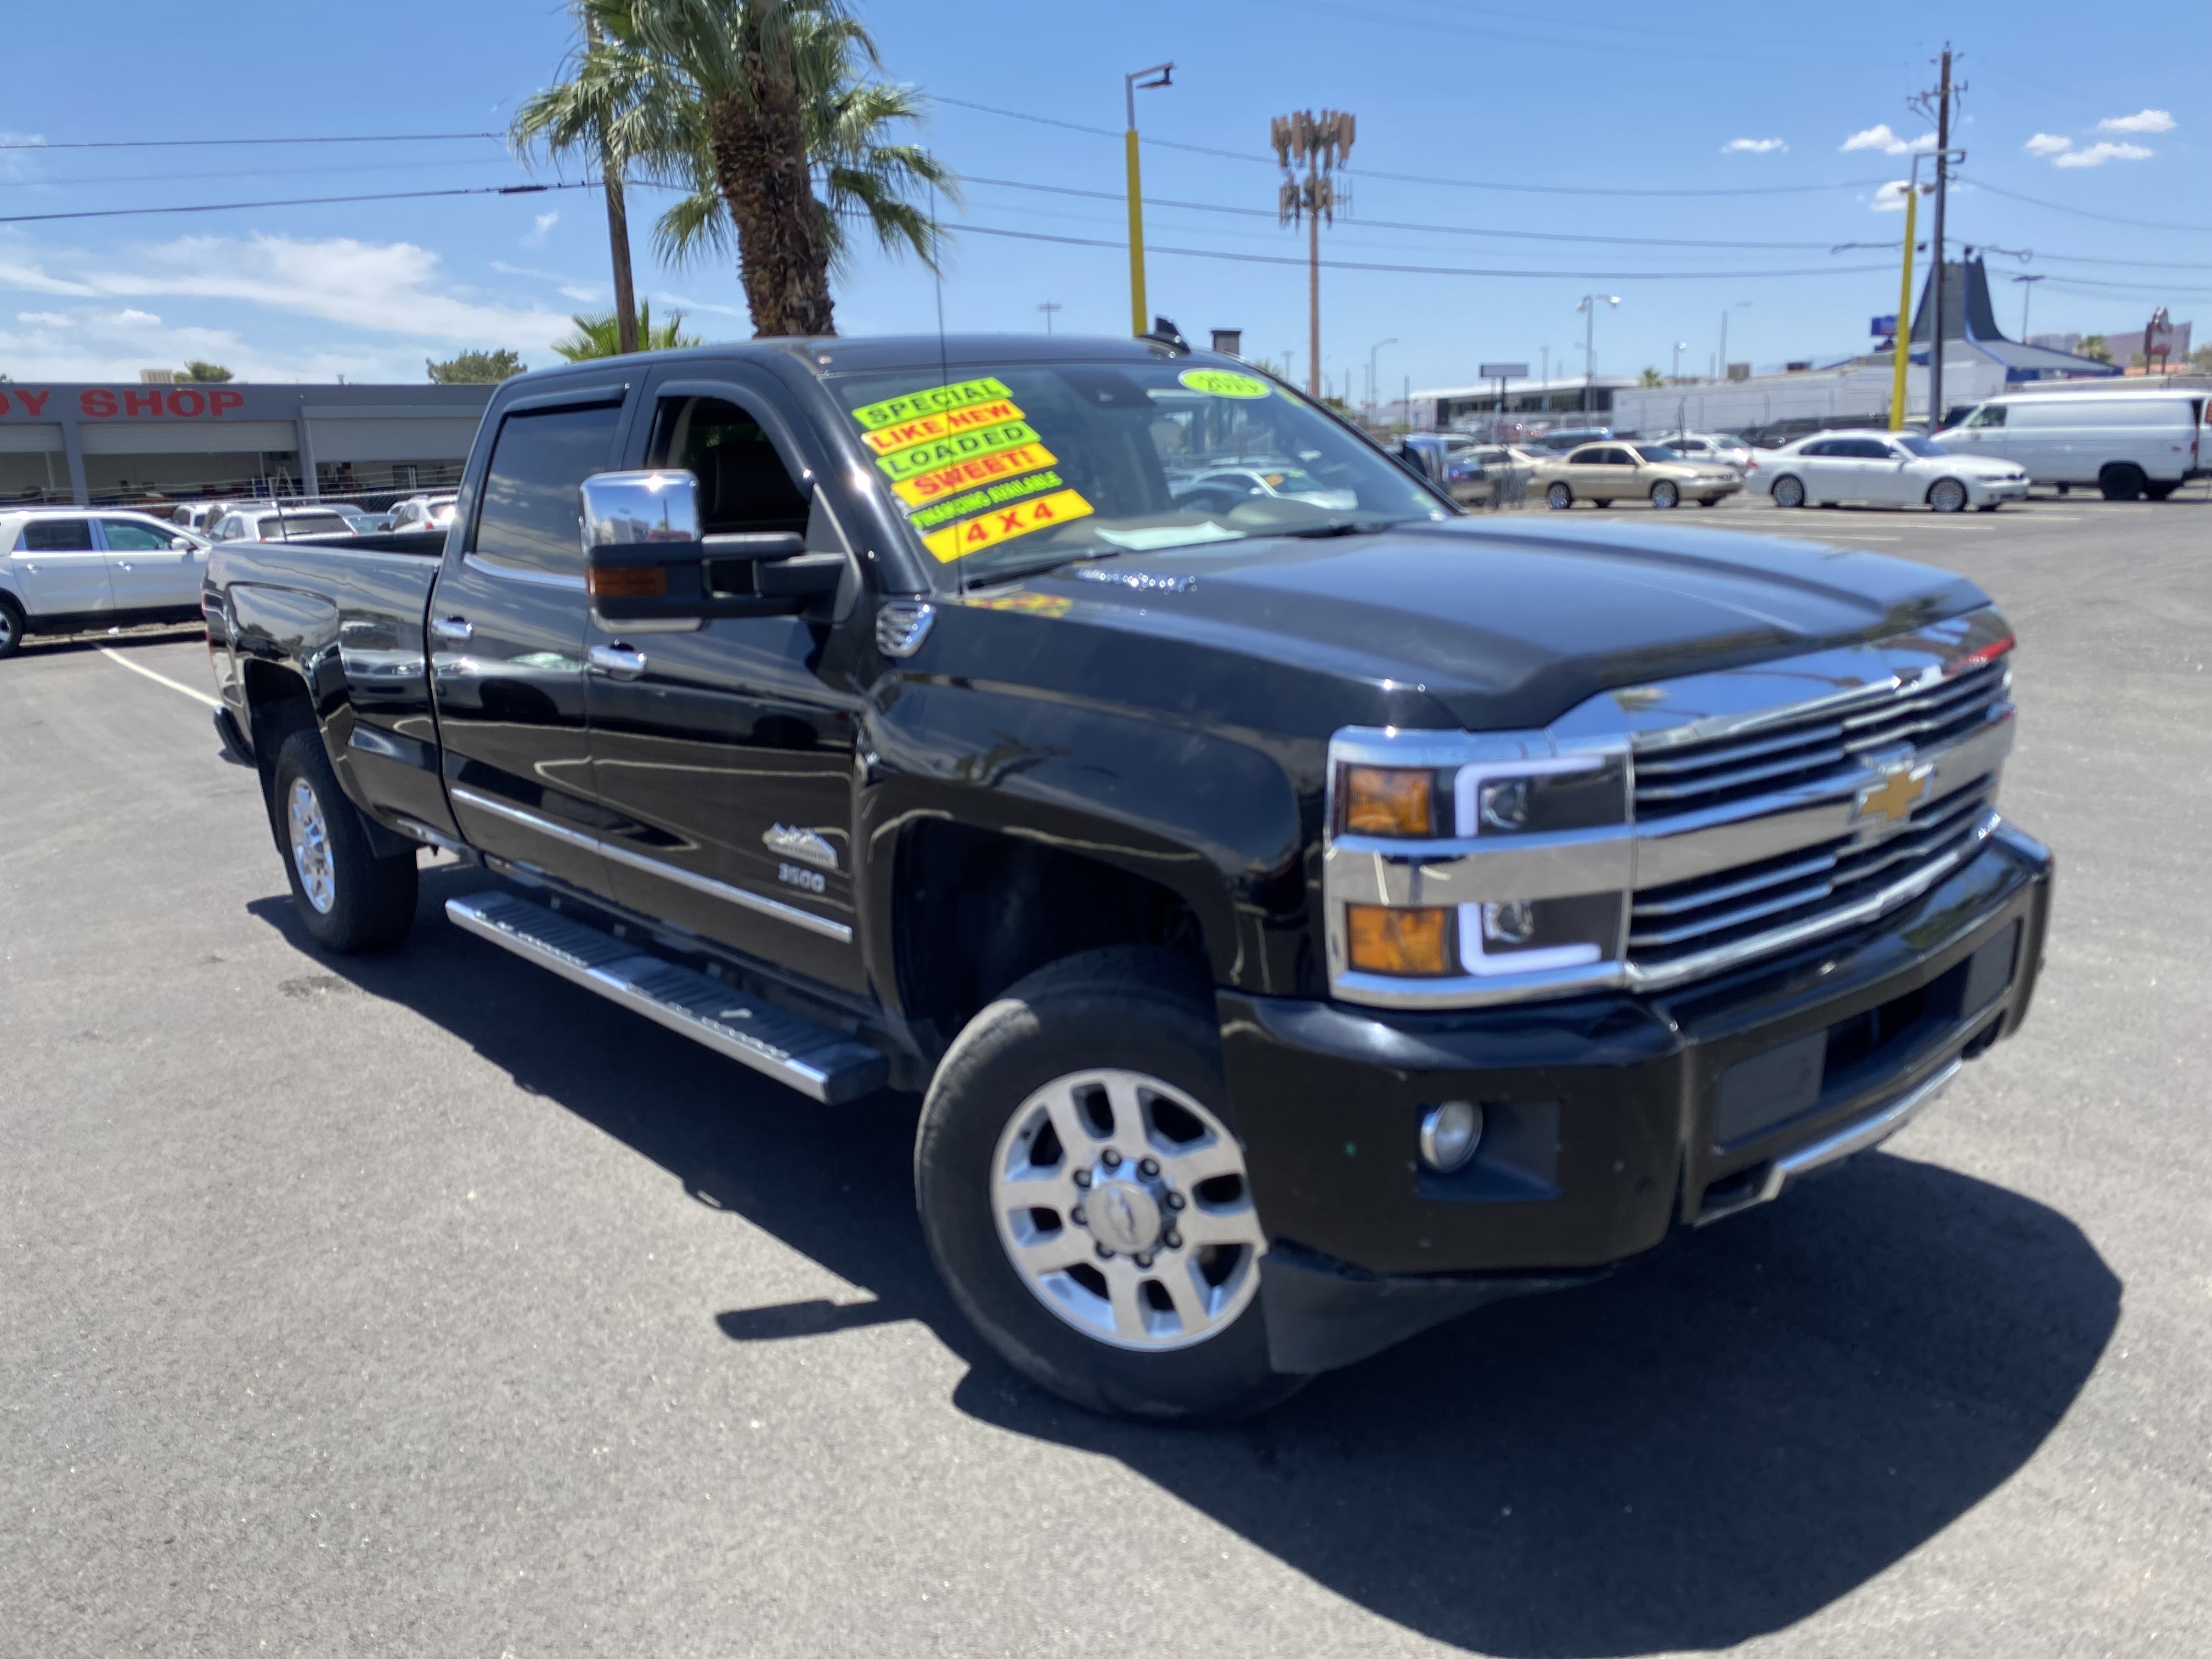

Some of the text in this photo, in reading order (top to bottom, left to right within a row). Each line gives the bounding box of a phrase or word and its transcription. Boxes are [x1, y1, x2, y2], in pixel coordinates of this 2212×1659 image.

[79, 388, 244, 417] SHOP
[867, 383, 1001, 424] SPECIAL
[872, 404, 1011, 449] LIKE NEW
[889, 427, 1024, 473] LOADED
[913, 449, 1035, 495] SWEET!
[909, 470, 1063, 530] FINANCING AVAILABLE
[967, 502, 1054, 542] 4 X 4
